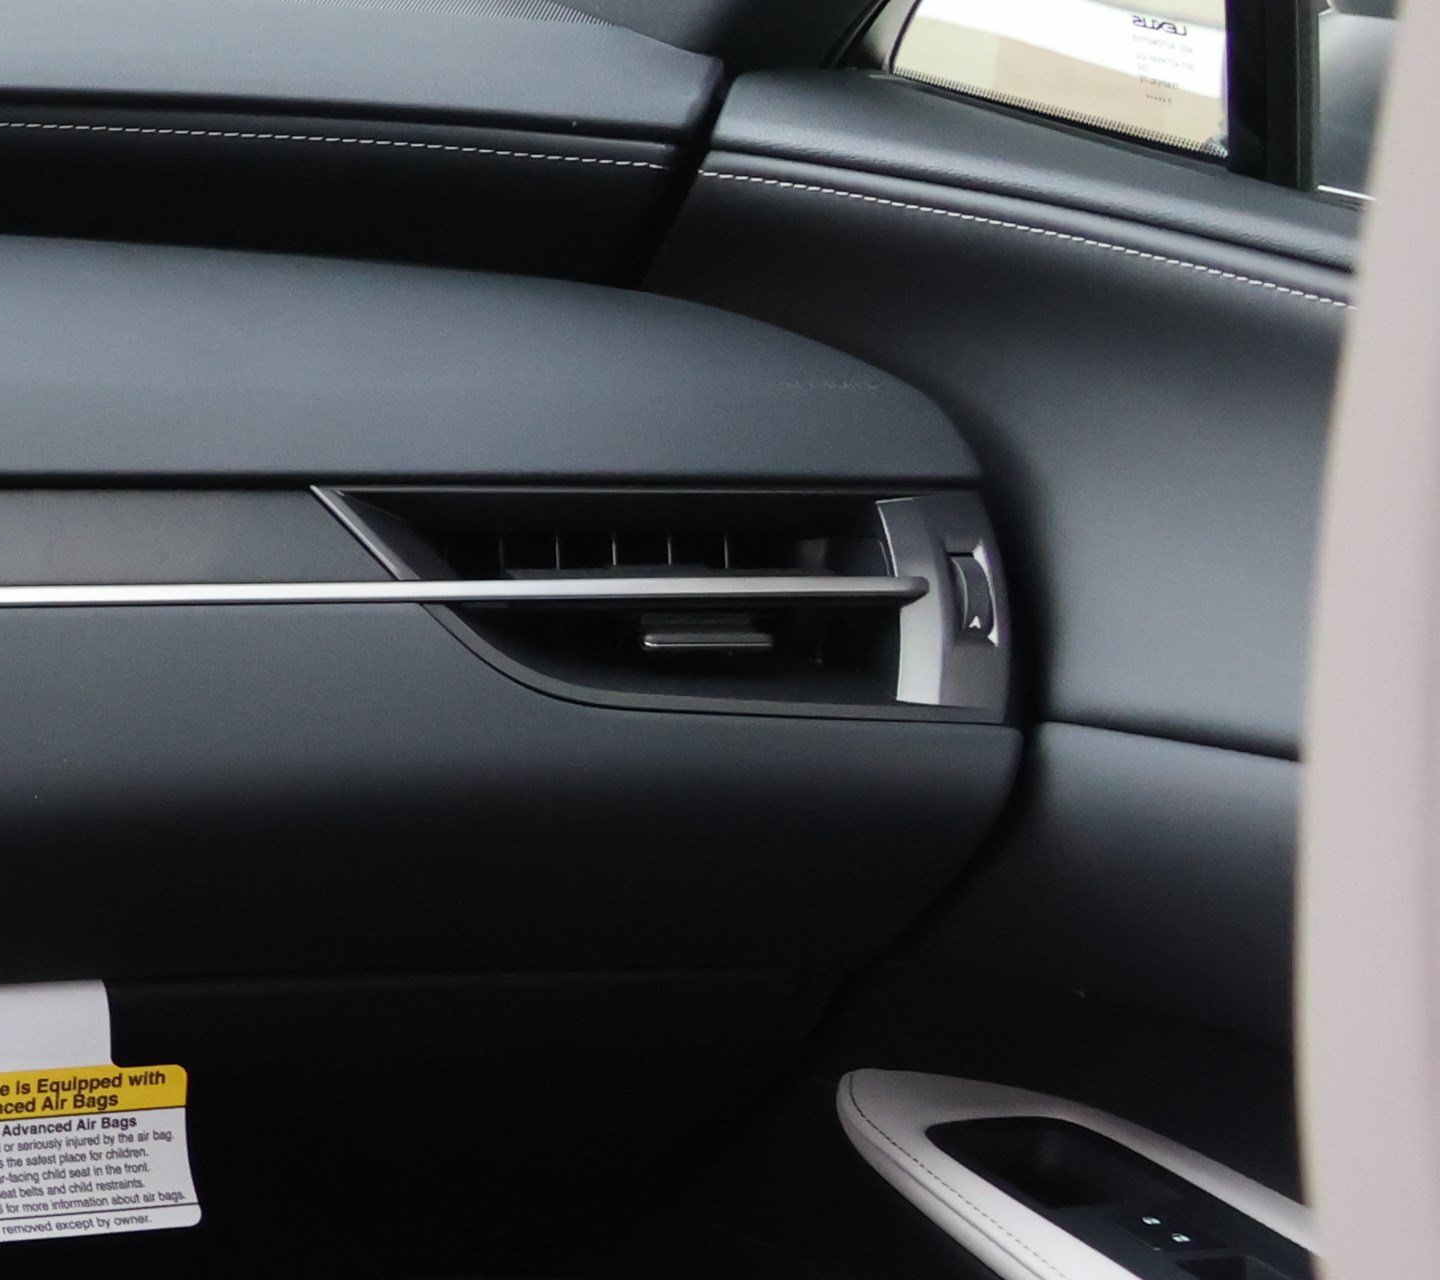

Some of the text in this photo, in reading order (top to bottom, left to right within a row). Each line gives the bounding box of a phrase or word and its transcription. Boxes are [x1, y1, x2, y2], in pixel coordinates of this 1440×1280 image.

[16, 1080, 31, 1095] is
[37, 1073, 122, 1095] Equipped
[128, 1071, 166, 1087] with
[41, 1096, 67, 1111] Air
[73, 1094, 119, 1111] Bags
[2, 1120, 72, 1137] Advanced
[76, 1118, 96, 1131] Air
[101, 1116, 137, 1130] Bags
[3, 1143, 14, 1152] or
[17, 1136, 62, 1151] seriously
[66, 1134, 100, 1148] injured
[103, 1133, 115, 1146] by
[118, 1132, 134, 1143] the
[137, 1131, 150, 1141] air
[153, 1129, 174, 1142] bag.
[6, 1156, 23, 1168] the
[26, 1153, 57, 1166] safest
[59, 1151, 87, 1165] place
[89, 1150, 103, 1161] for
[105, 1147, 149, 1160] children.
[43, 1169, 67, 1181] child
[70, 1166, 91, 1178] seat
[93, 1166, 103, 1176] in
[105, 1164, 122, 1175] the
[124, 1162, 150, 1173] front.
[19, 1184, 44, 1198] belts
[47, 1183, 67, 1195] and
[69, 1180, 93, 1193] child
[95, 1178, 146, 1191] restraints.
[6, 1202, 19, 1214] for
[22, 1201, 49, 1212] more
[52, 1196, 109, 1210] information
[111, 1193, 140, 1205] about
[143, 1192, 156, 1202] air
[158, 1190, 186, 1203] bags.
[2, 1220, 53, 1235] removed
[56, 1217, 94, 1231] except
[97, 1215, 112, 1228] by
[114, 1214, 152, 1226] owner.
